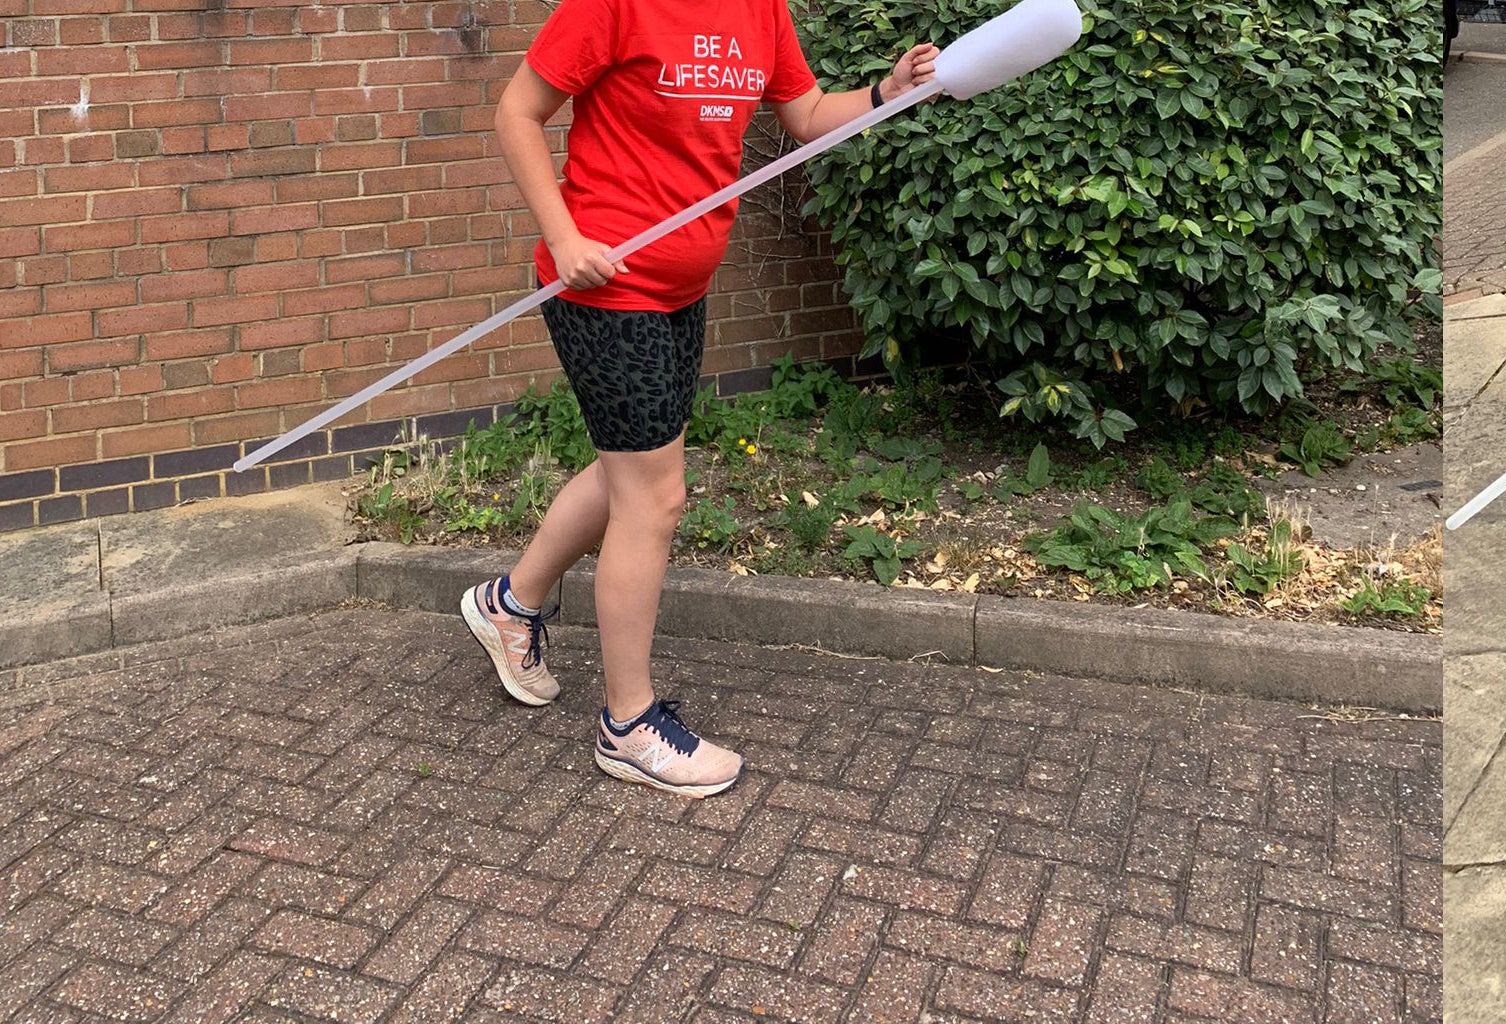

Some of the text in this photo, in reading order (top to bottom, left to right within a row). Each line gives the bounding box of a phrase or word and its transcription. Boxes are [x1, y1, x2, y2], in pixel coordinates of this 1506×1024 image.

[694, 34, 743, 60] BE A
[657, 63, 767, 92] LIFESAVER
[700, 105, 725, 117] DKMS
